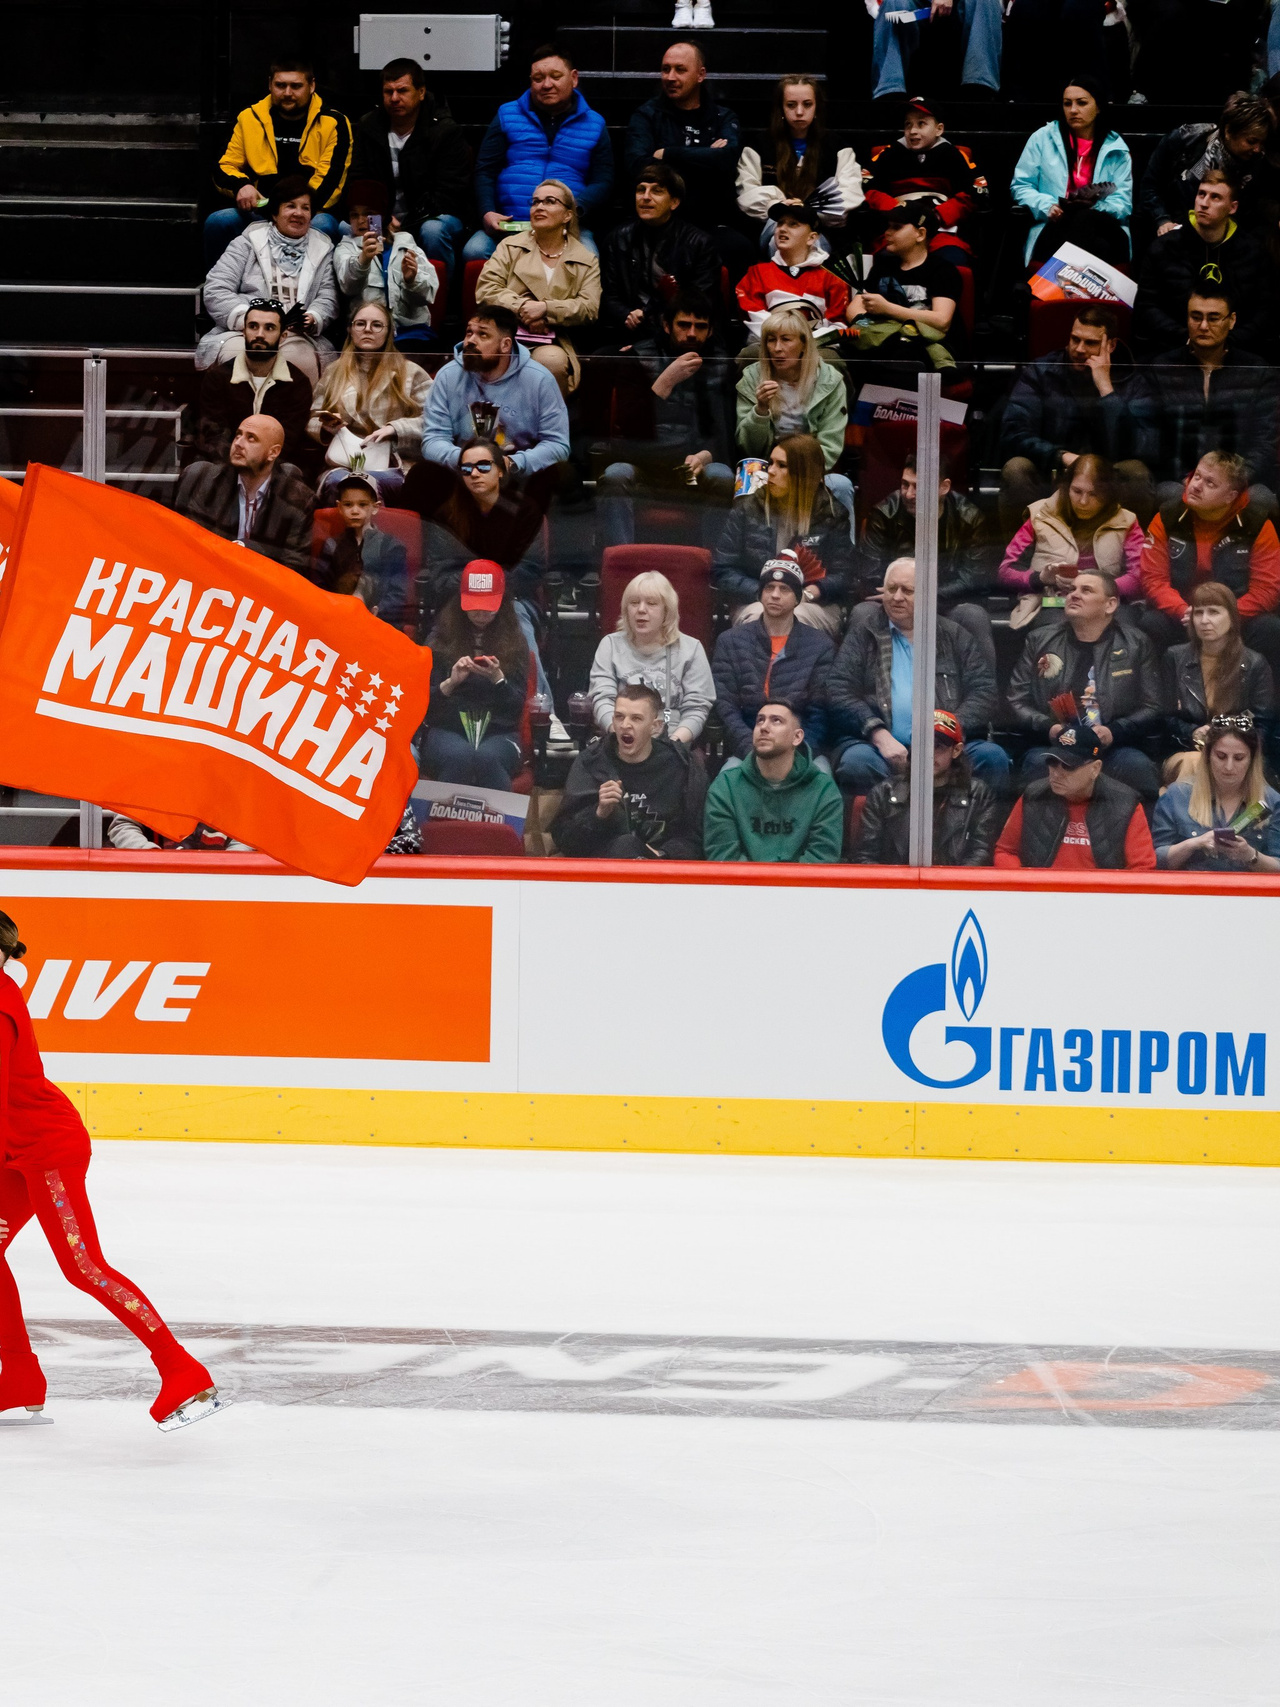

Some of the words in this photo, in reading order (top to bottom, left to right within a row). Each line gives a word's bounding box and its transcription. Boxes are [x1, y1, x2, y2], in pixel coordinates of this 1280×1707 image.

[75, 557, 340, 685] КРАСНАЯ
[42, 614, 387, 799] МАШИНА
[999, 1026, 1267, 1097] ГАЗПРОМ
